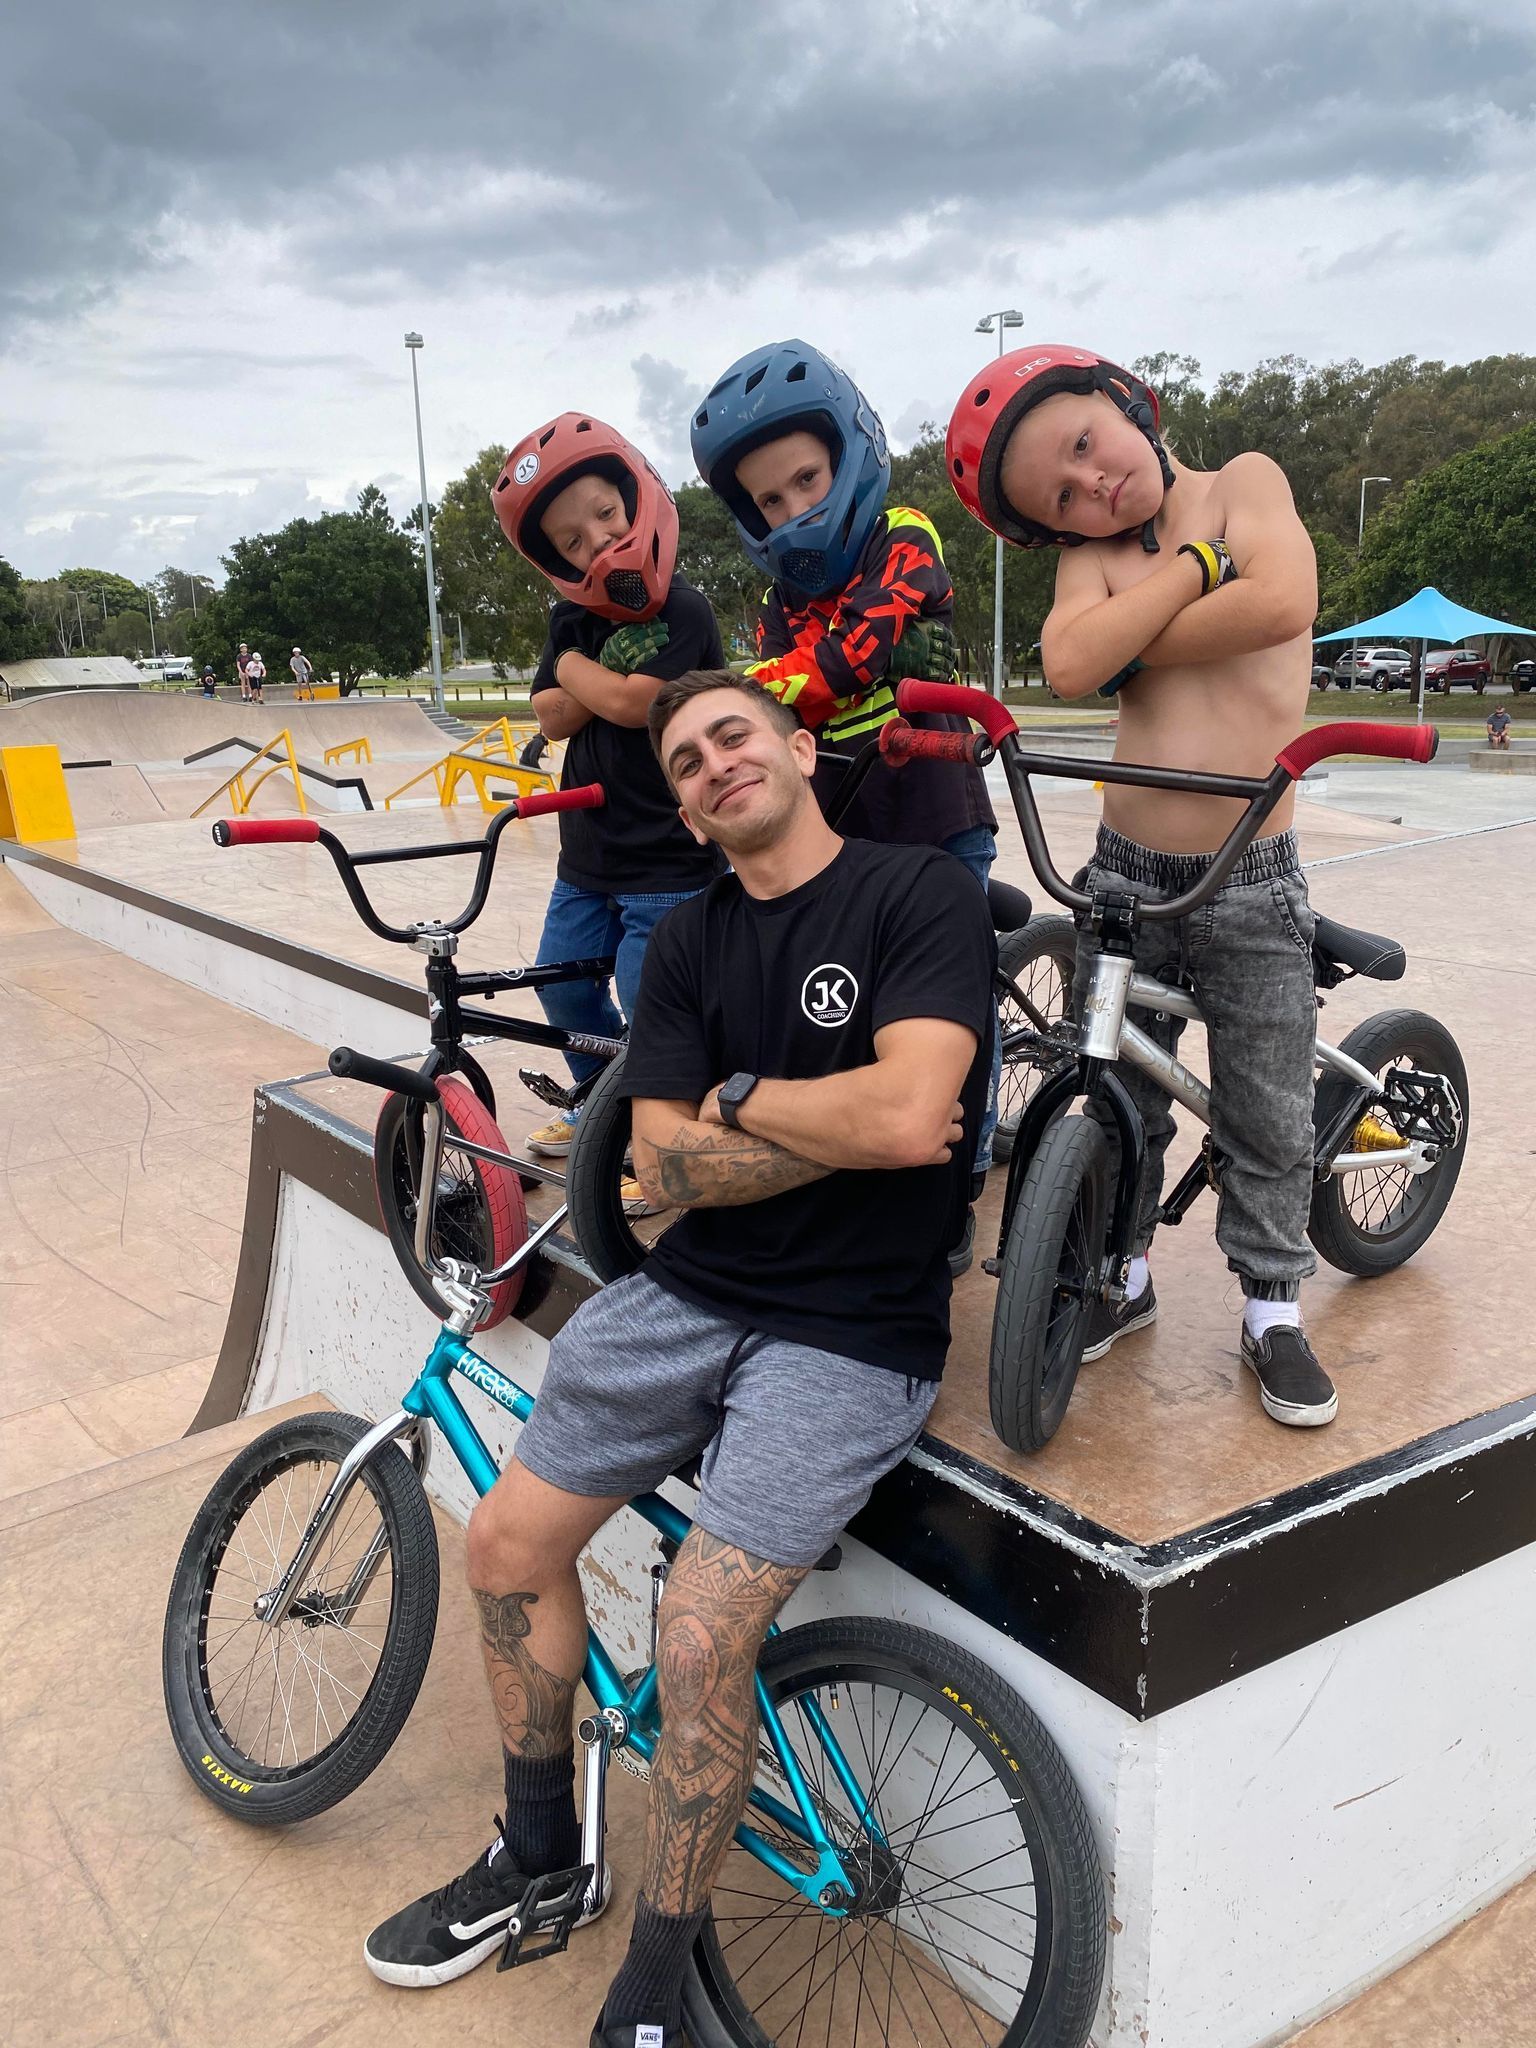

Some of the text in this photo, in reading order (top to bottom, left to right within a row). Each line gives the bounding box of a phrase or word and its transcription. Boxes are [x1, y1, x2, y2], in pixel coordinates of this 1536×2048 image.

[518, 457, 537, 478] JK
[811, 979, 849, 1011] JK
[816, 1011, 846, 1020] COACHING
[941, 1686, 1020, 1772] MAXXIS
[201, 1755, 254, 1793] MAXXIS
[640, 2031, 660, 2042] VANS
